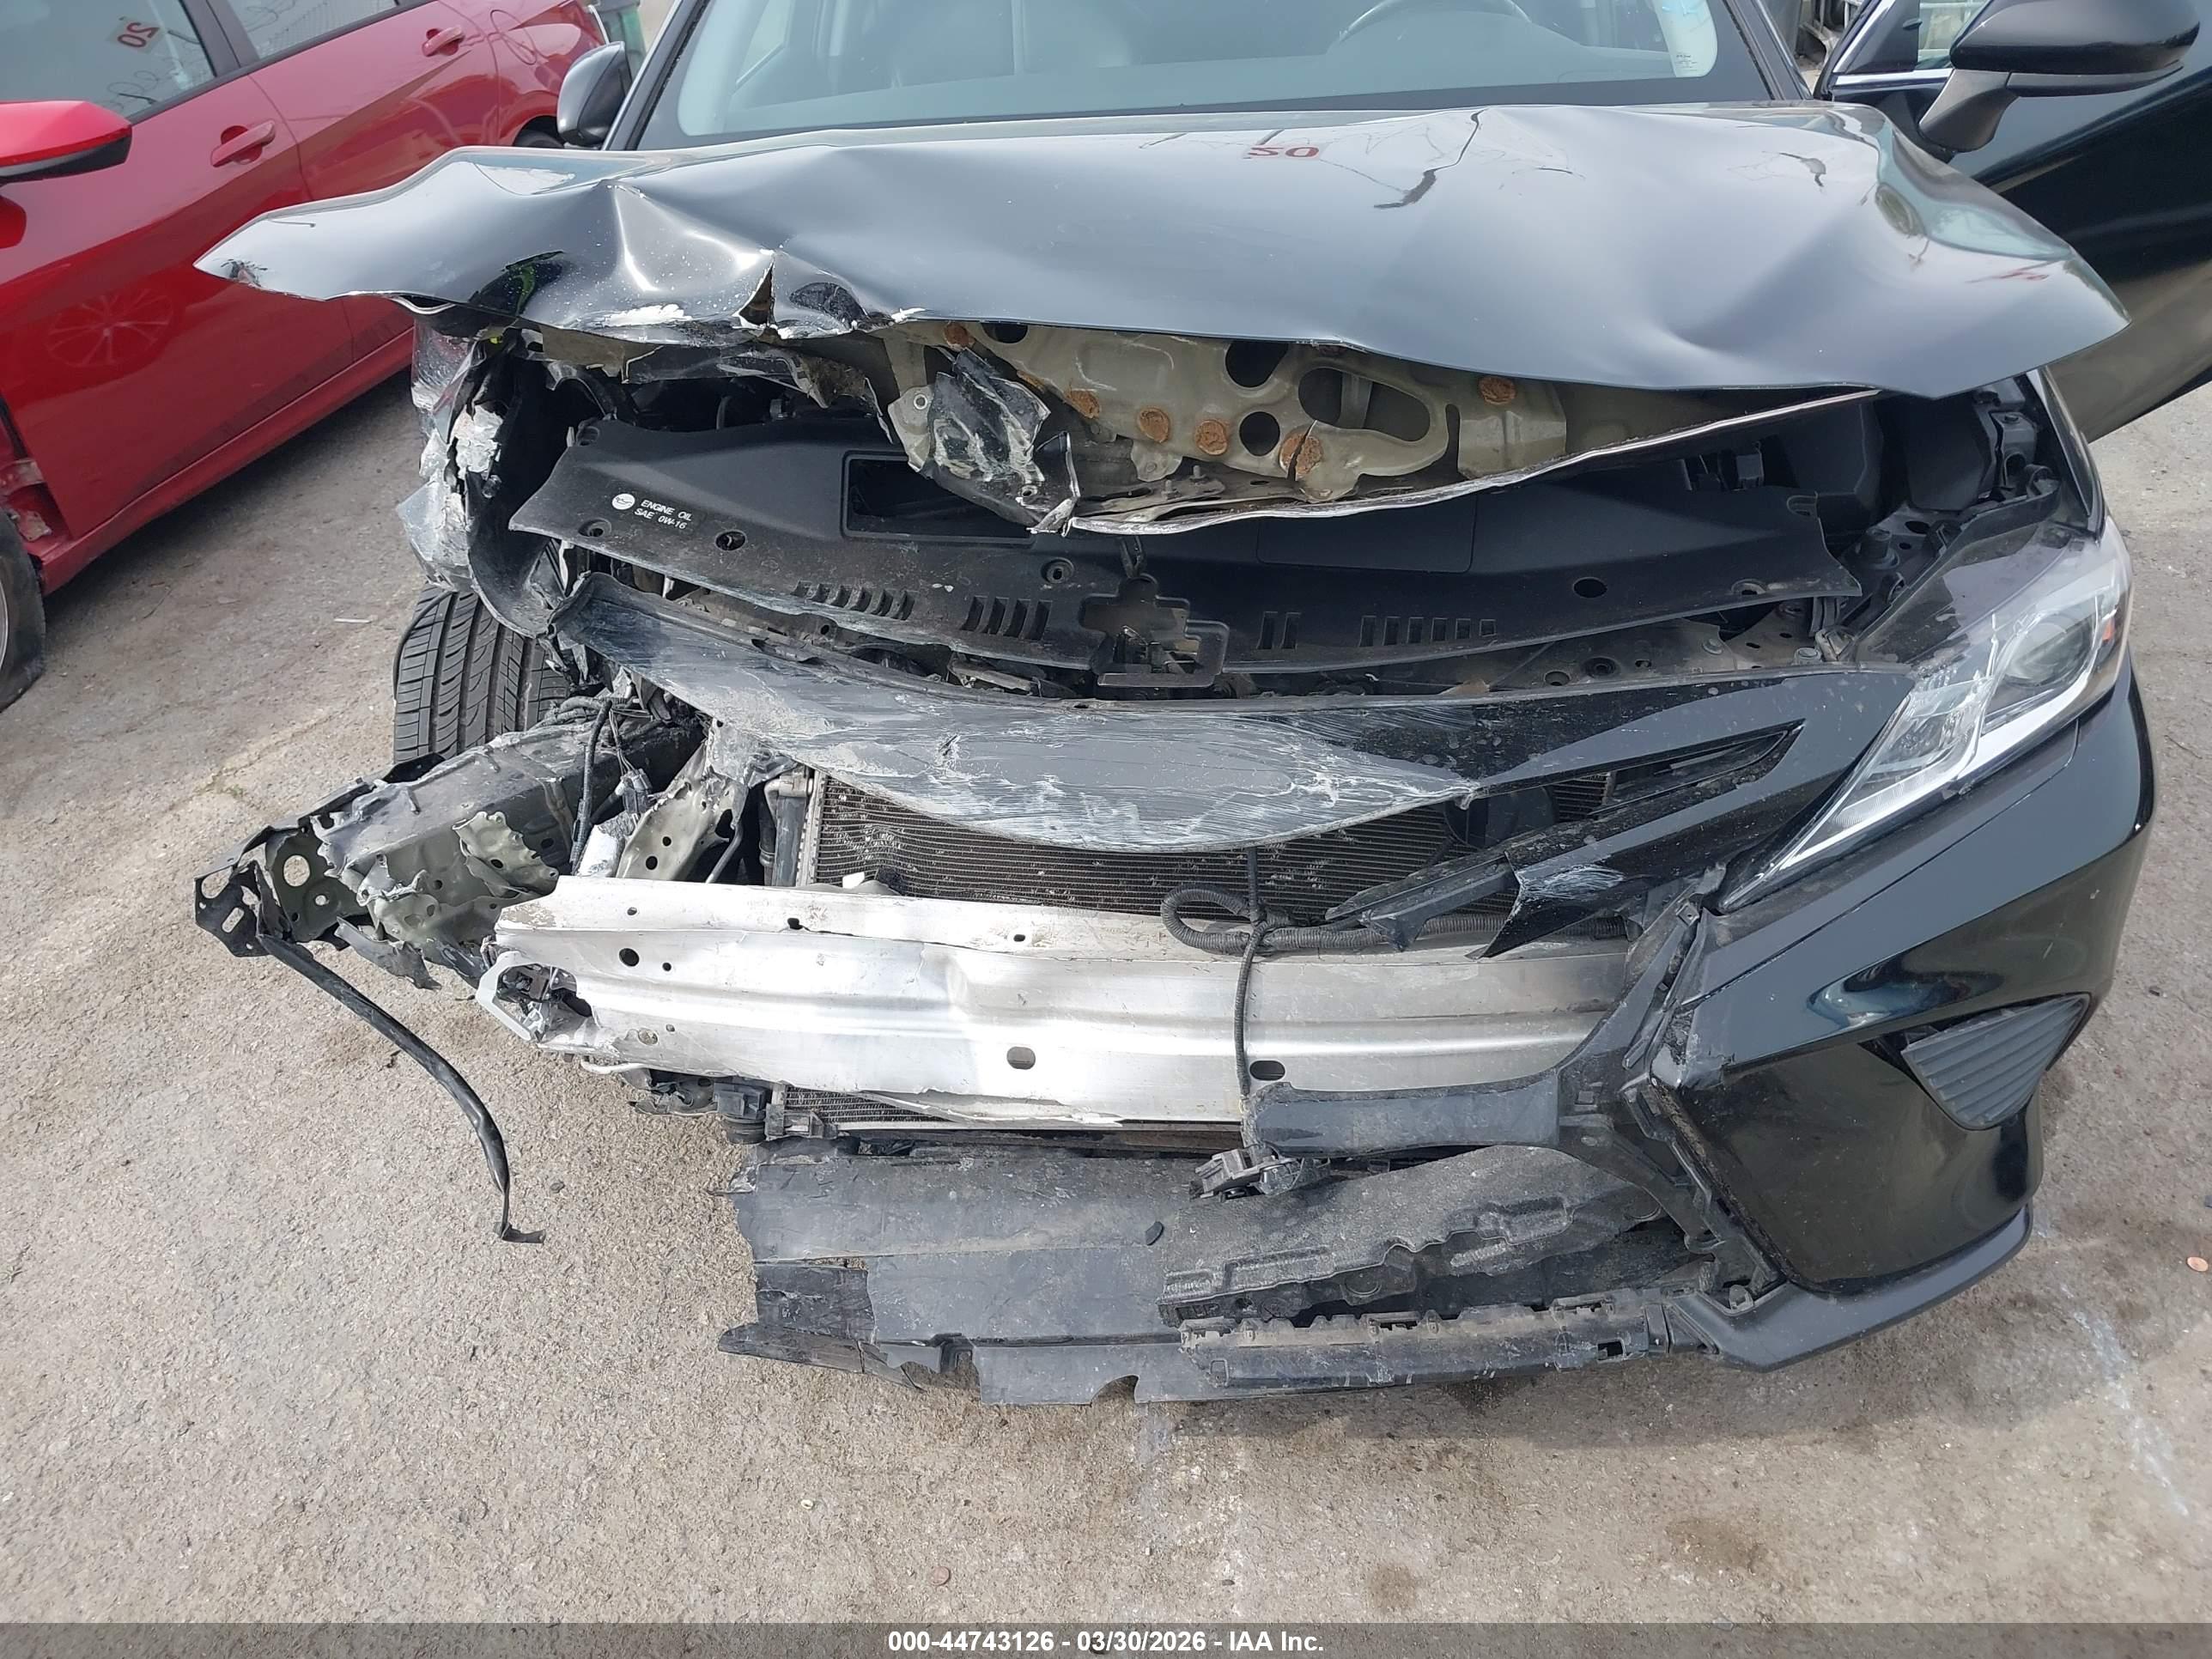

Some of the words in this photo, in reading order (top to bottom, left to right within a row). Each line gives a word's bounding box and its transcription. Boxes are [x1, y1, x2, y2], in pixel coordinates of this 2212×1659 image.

[634, 507, 655, 520] SAE
[657, 515, 688, 530] 0W-16
[641, 499, 676, 515] ENGINE
[678, 511, 692, 521] OIL
